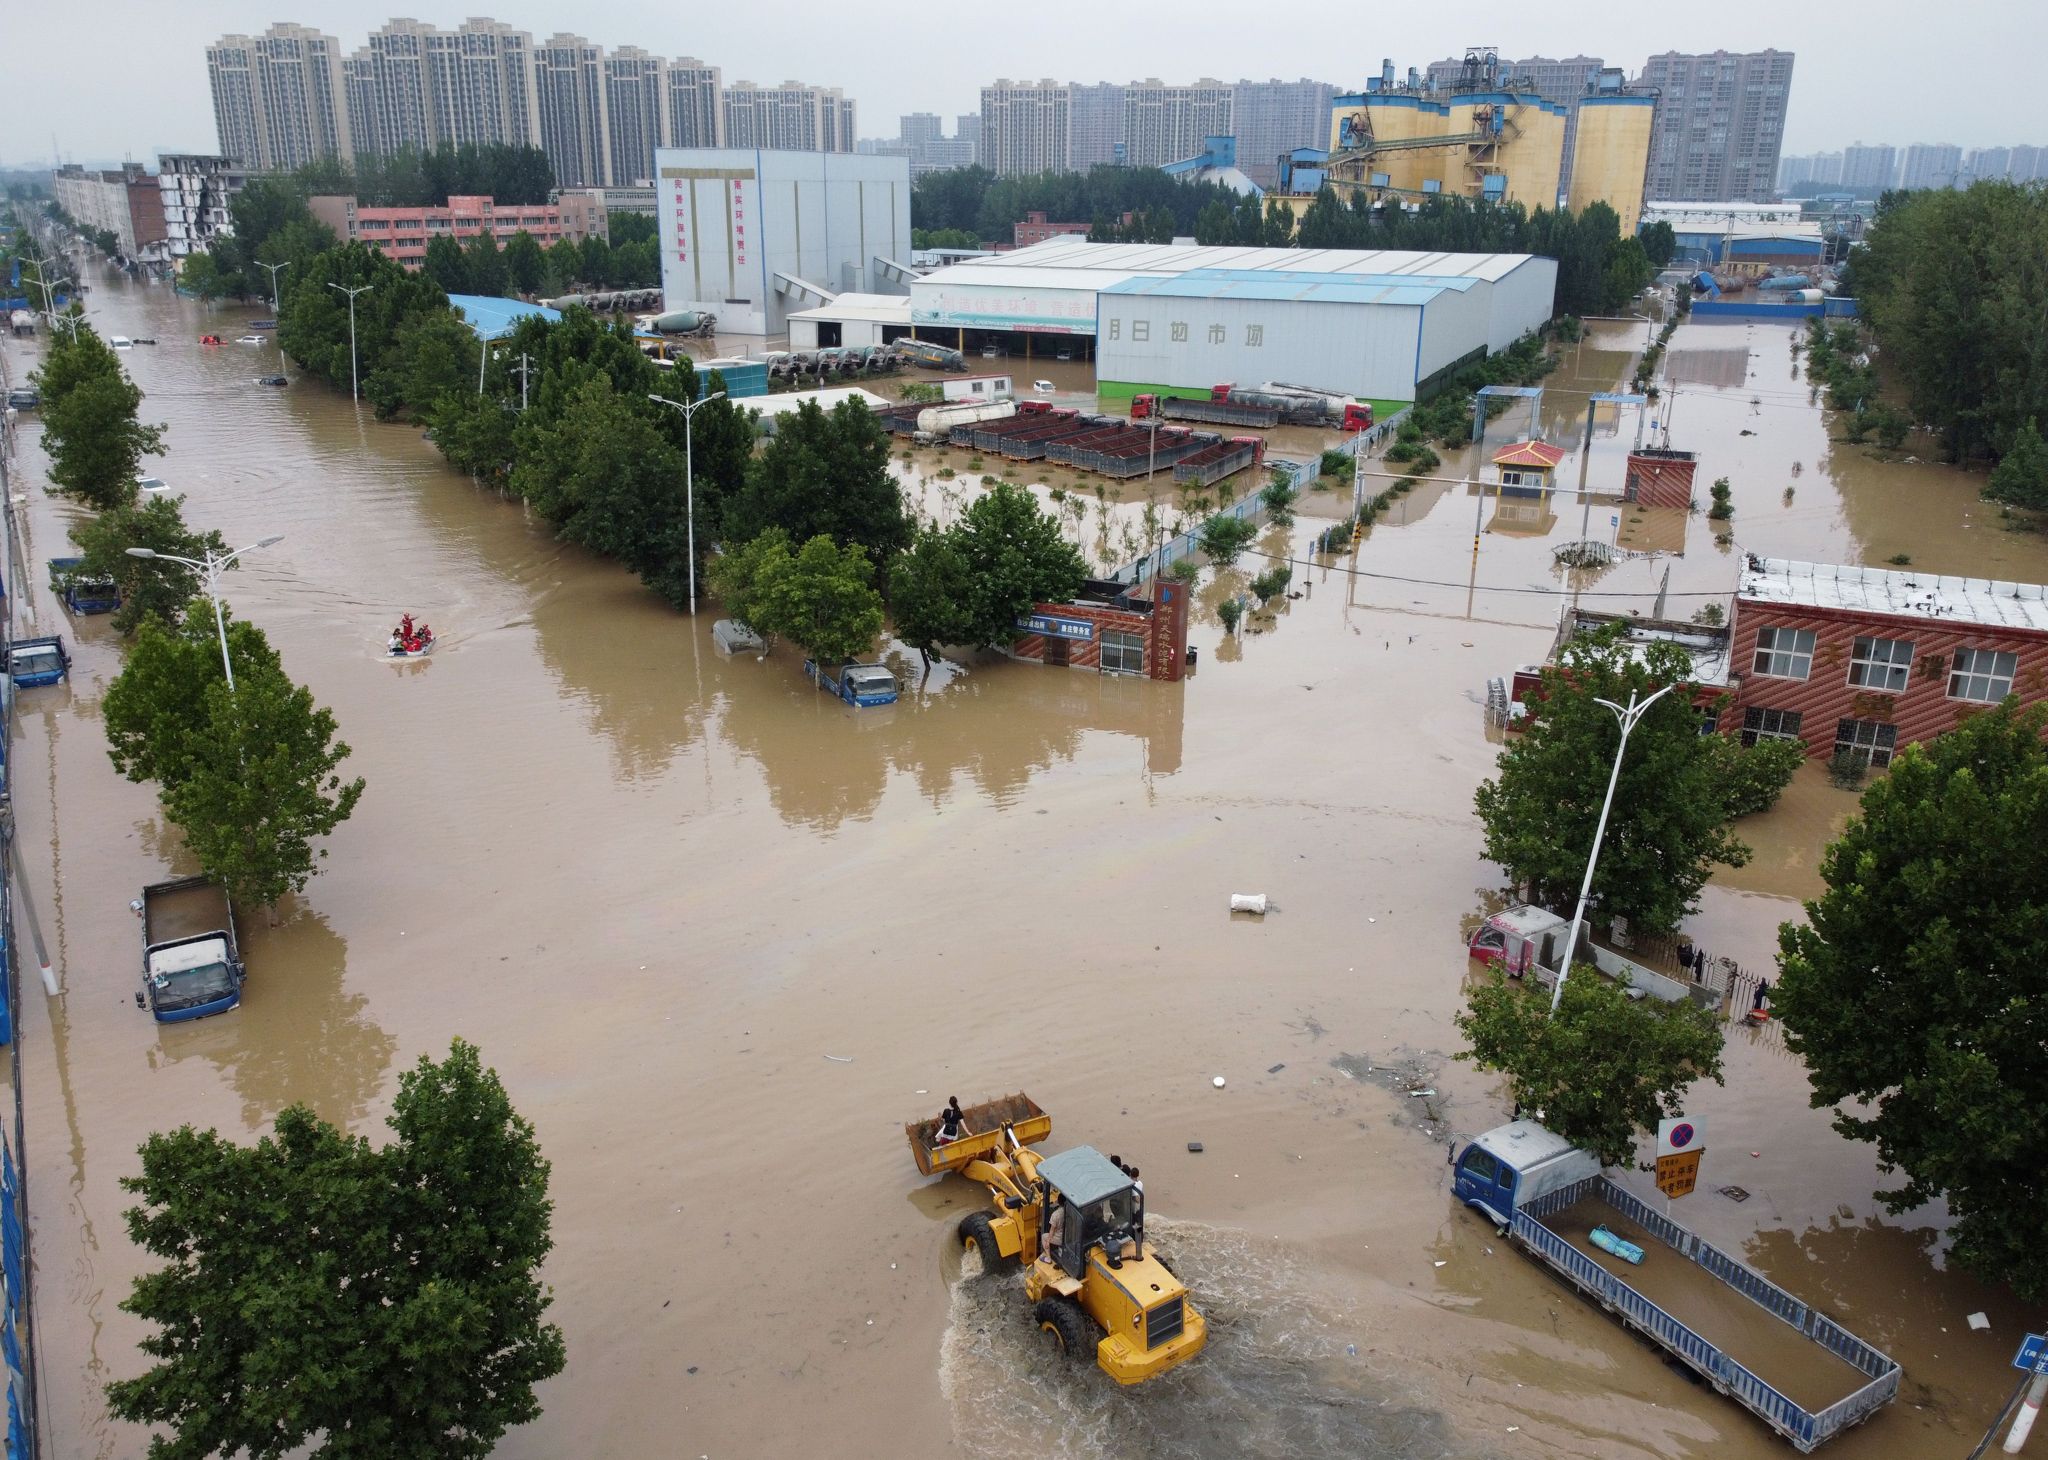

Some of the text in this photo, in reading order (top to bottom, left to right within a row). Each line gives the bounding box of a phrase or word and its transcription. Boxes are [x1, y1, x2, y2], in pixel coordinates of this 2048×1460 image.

[733, 178, 745, 264] 落实环境责任
[1659, 1164, 1694, 1181] 禁止停车
